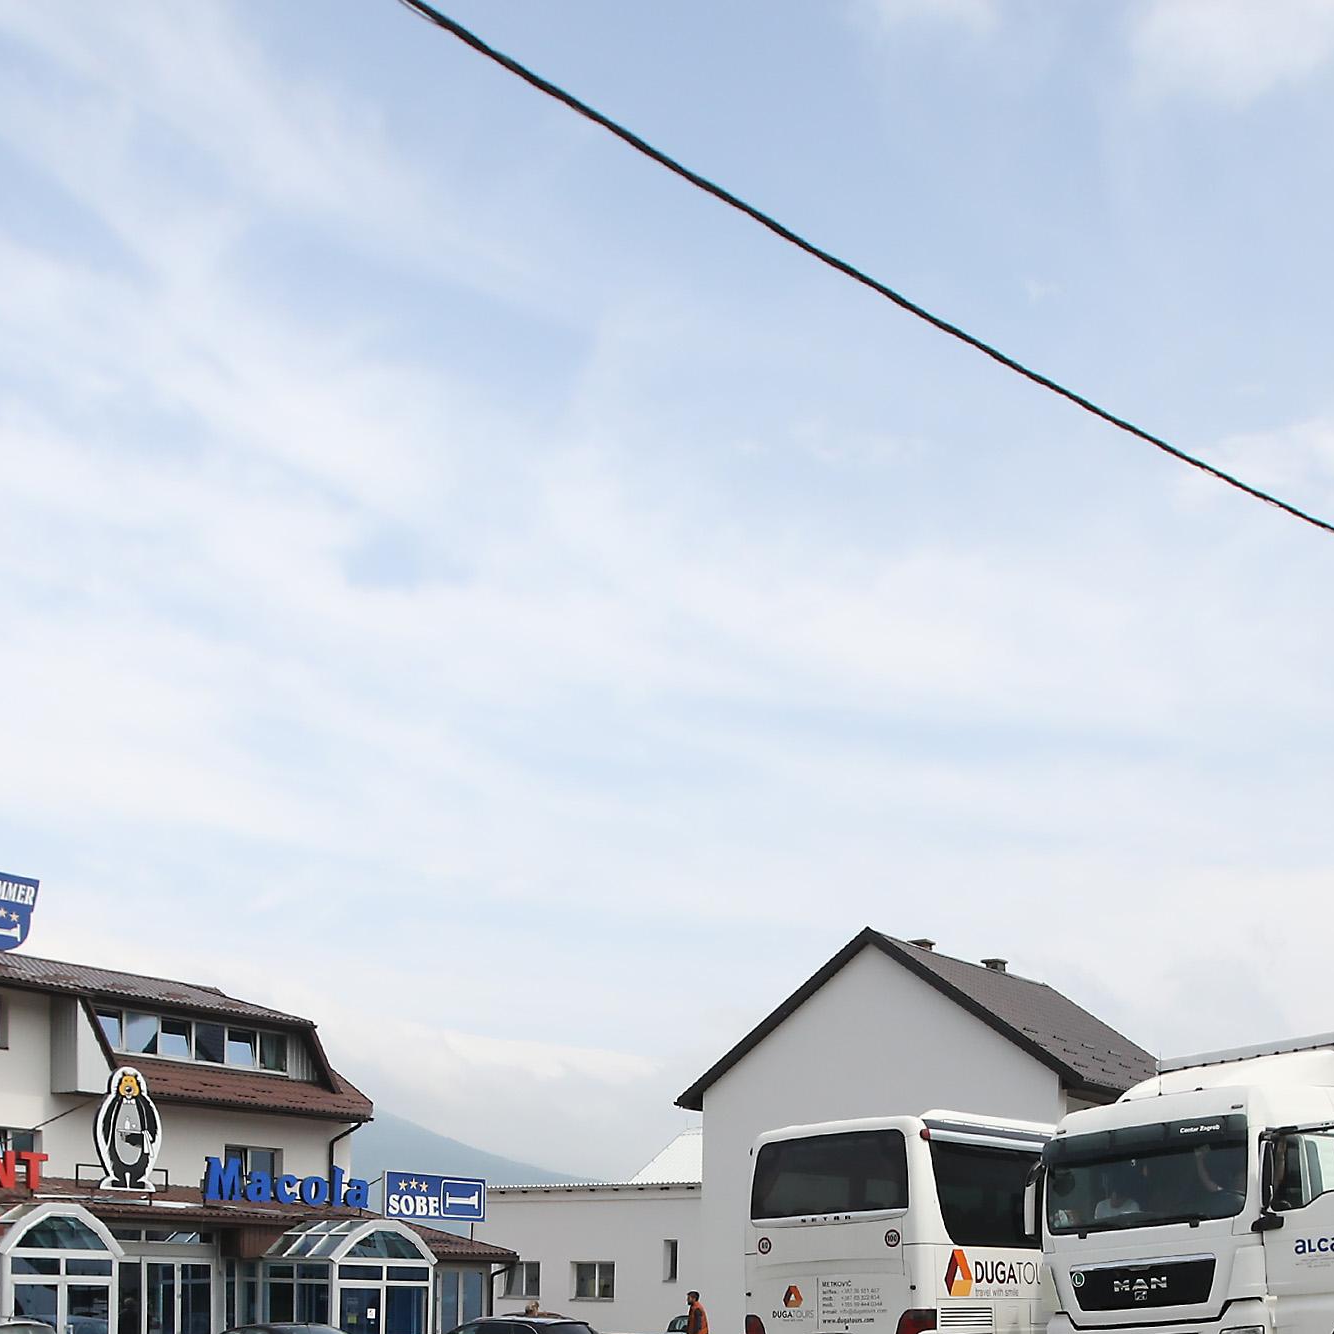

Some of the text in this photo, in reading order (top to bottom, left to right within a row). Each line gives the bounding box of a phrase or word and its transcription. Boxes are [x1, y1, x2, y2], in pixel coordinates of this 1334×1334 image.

[204, 1156, 368, 1209] Macola
[387, 1194, 440, 1217] SOBE
[975, 1288, 1019, 1296] travel with smile
[1113, 1276, 1167, 1292] MAN
[772, 1310, 815, 1318] DUGATOURS
